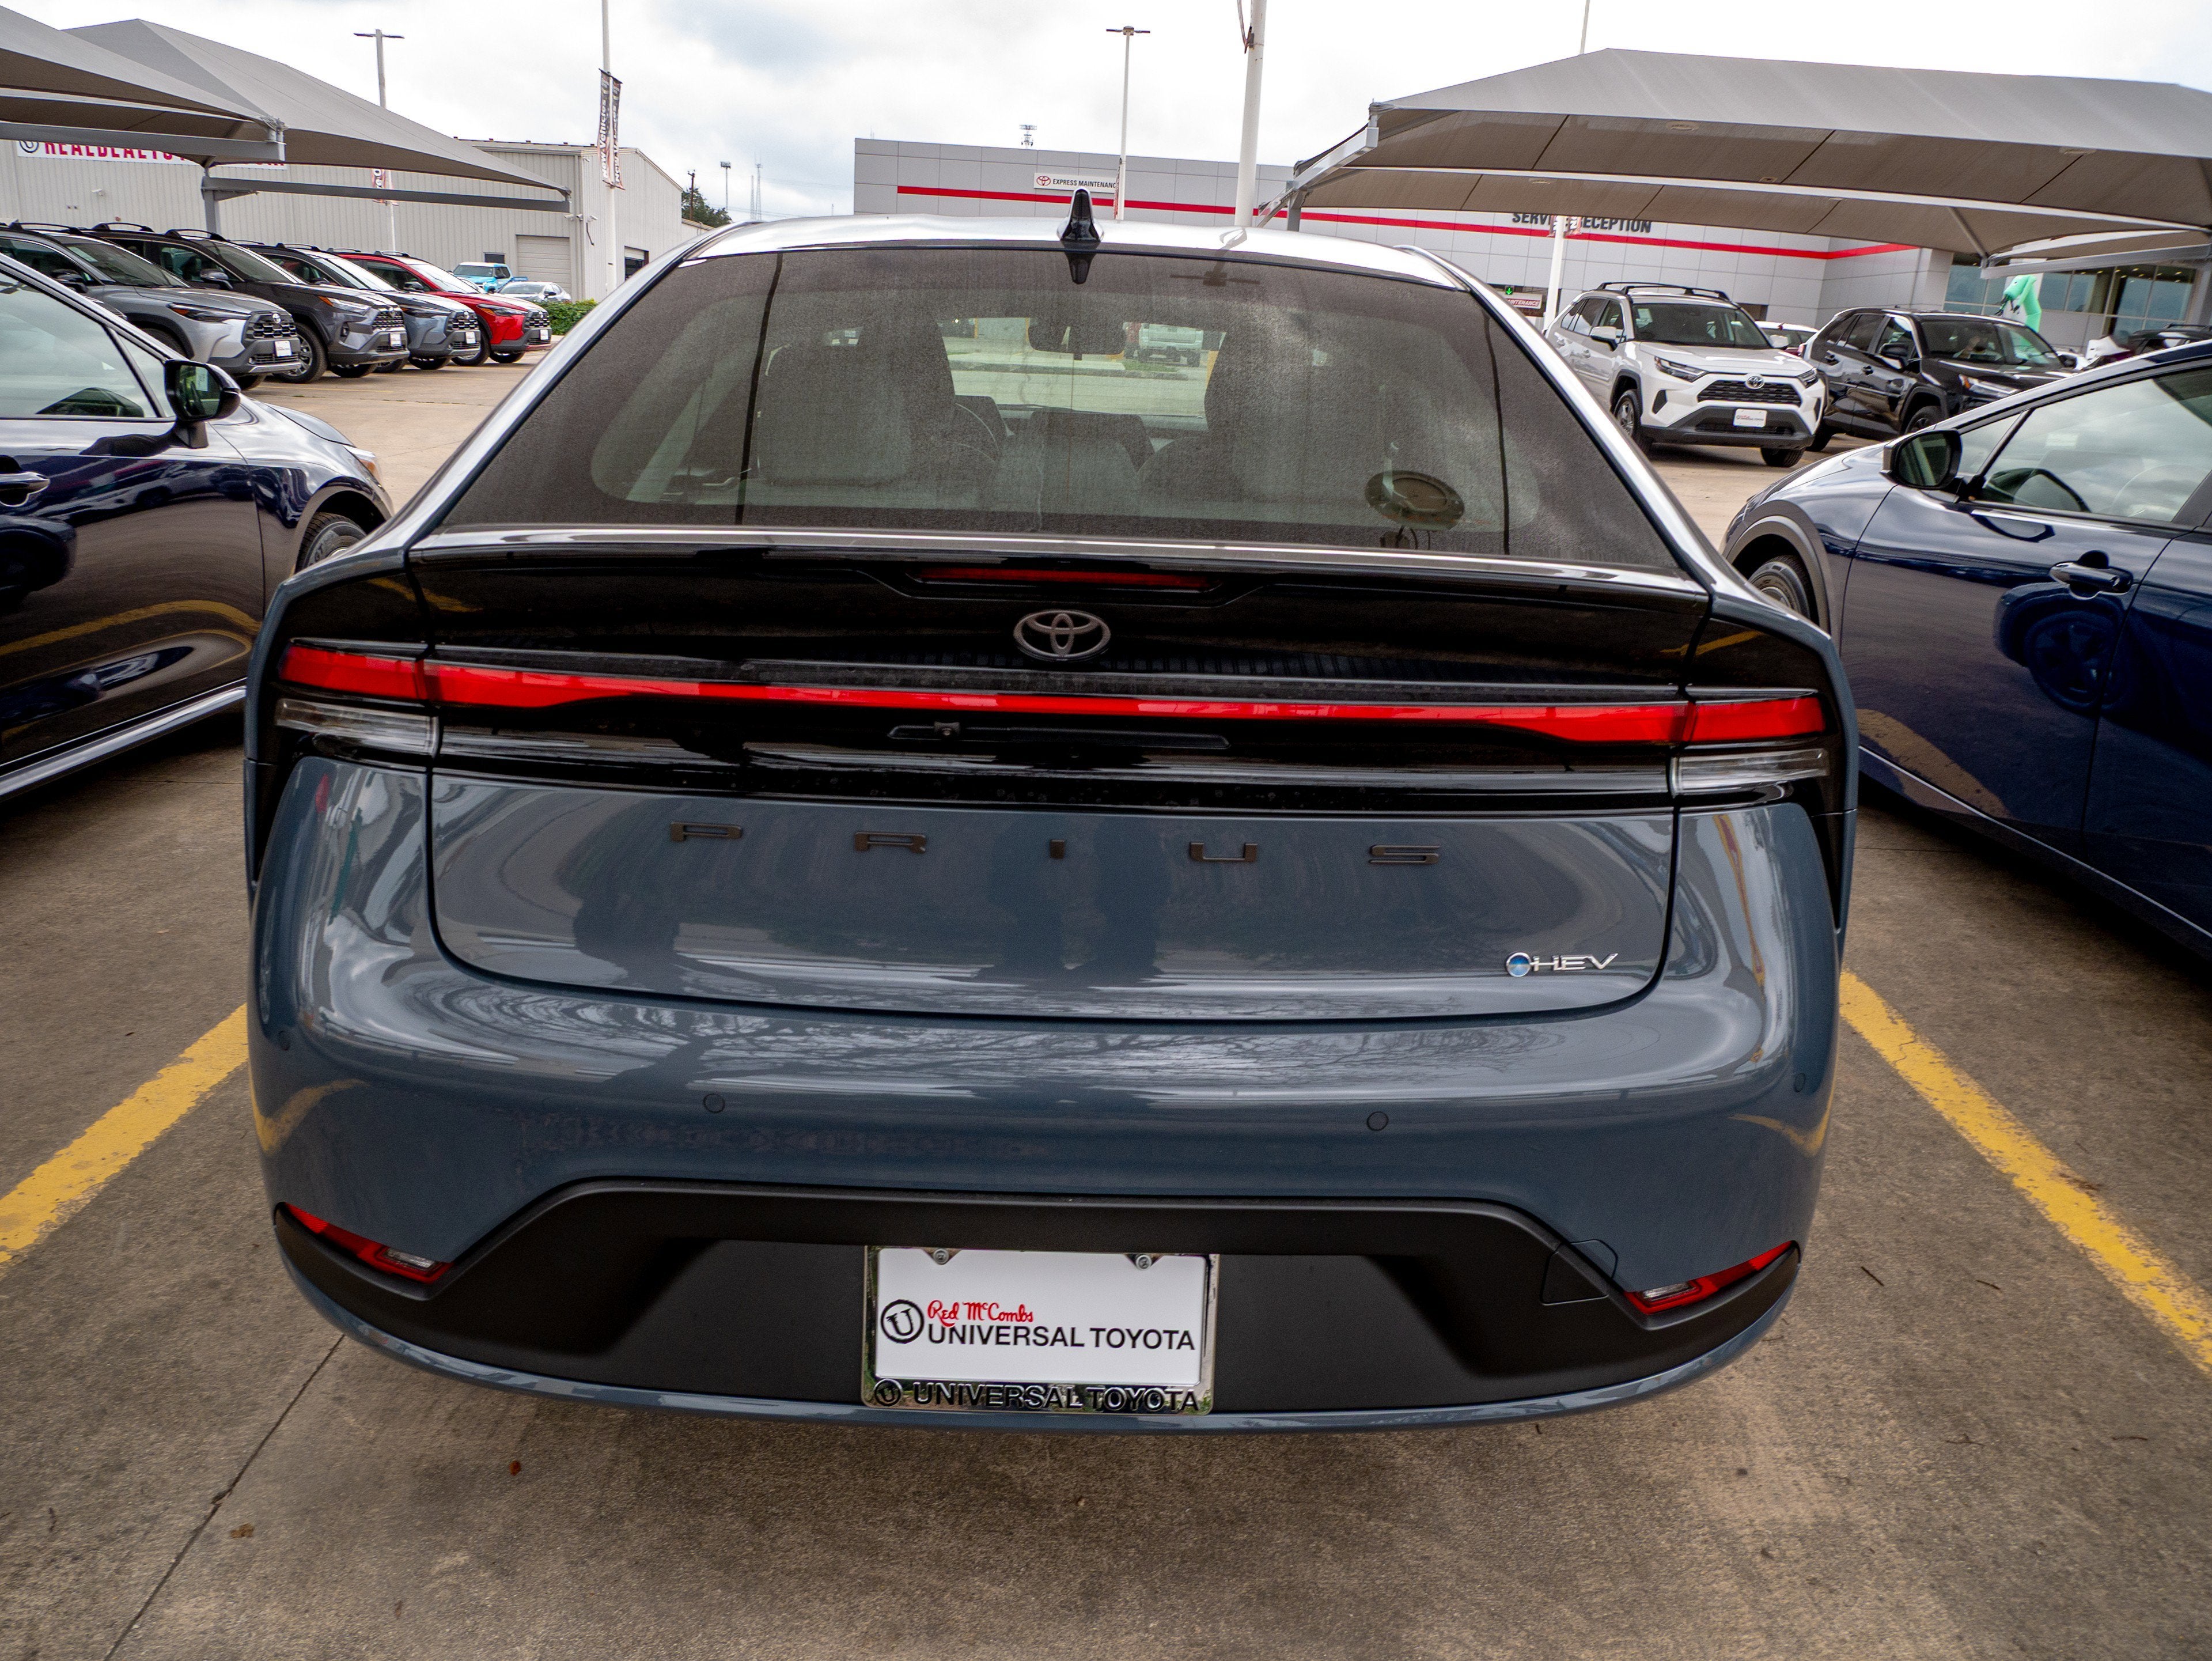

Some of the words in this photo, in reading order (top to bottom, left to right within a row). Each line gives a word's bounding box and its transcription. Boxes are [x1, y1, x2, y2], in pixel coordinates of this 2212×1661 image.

[1581, 217, 1652, 233] ECEPTION
[670, 822, 1440, 865] PRIUS
[1533, 952, 1618, 972] HEV
[928, 1300, 959, 1327] Red
[963, 1302, 1033, 1323] McCombs
[928, 1323, 1085, 1347] UNIVERSAL
[1089, 1327, 1195, 1350] TOYOTA
[912, 1382, 1084, 1409] UNIVERSAL
[1085, 1386, 1200, 1412] TOYOTA
